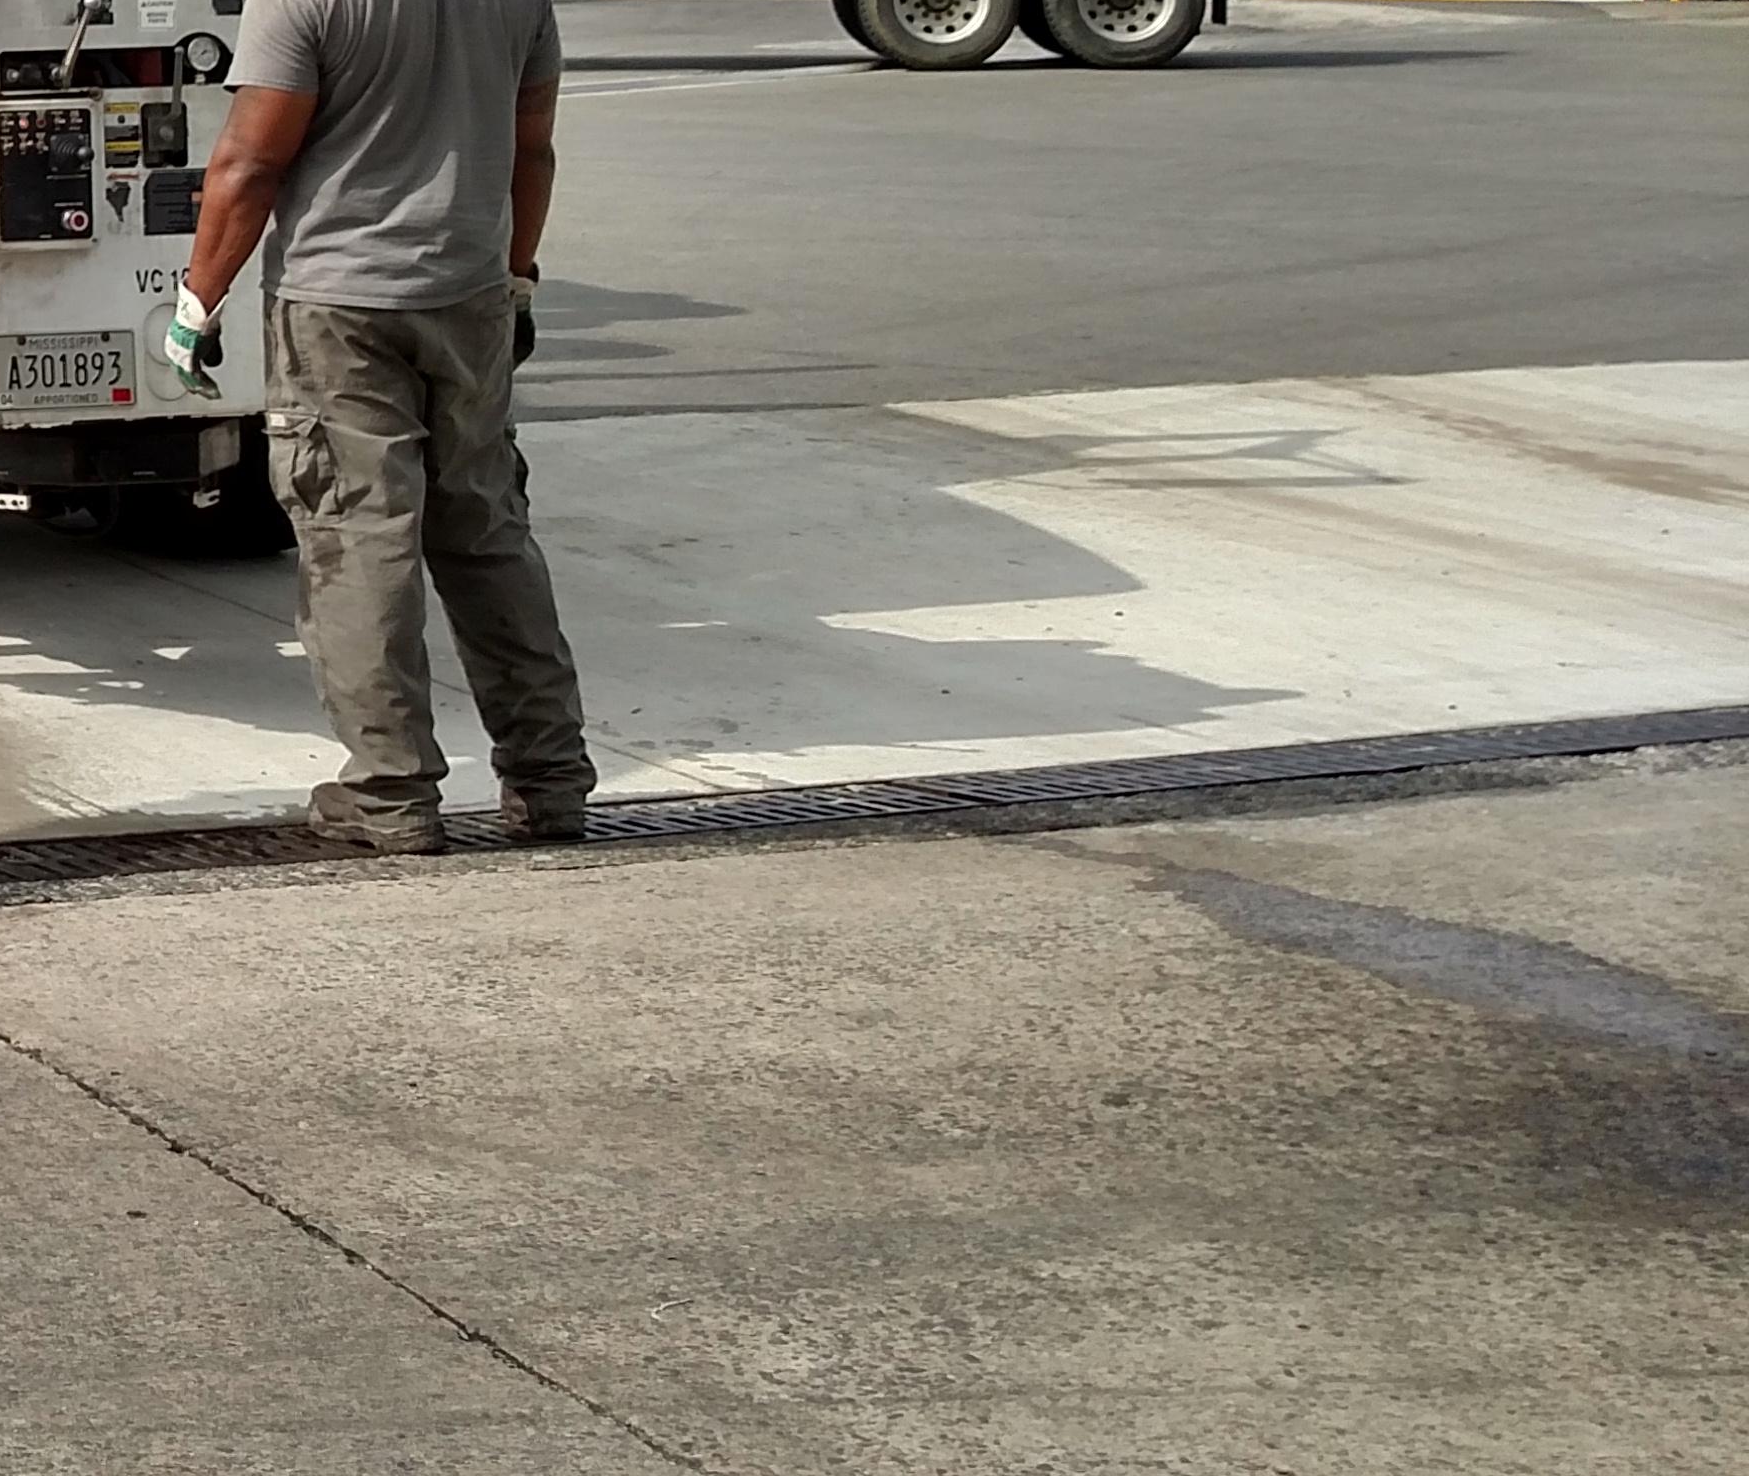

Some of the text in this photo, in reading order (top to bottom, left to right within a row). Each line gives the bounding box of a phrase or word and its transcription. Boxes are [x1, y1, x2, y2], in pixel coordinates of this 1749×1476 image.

[135, 269, 163, 293] VC
[29, 335, 99, 350] MISSISSIPPI
[8, 351, 121, 390] A301893
